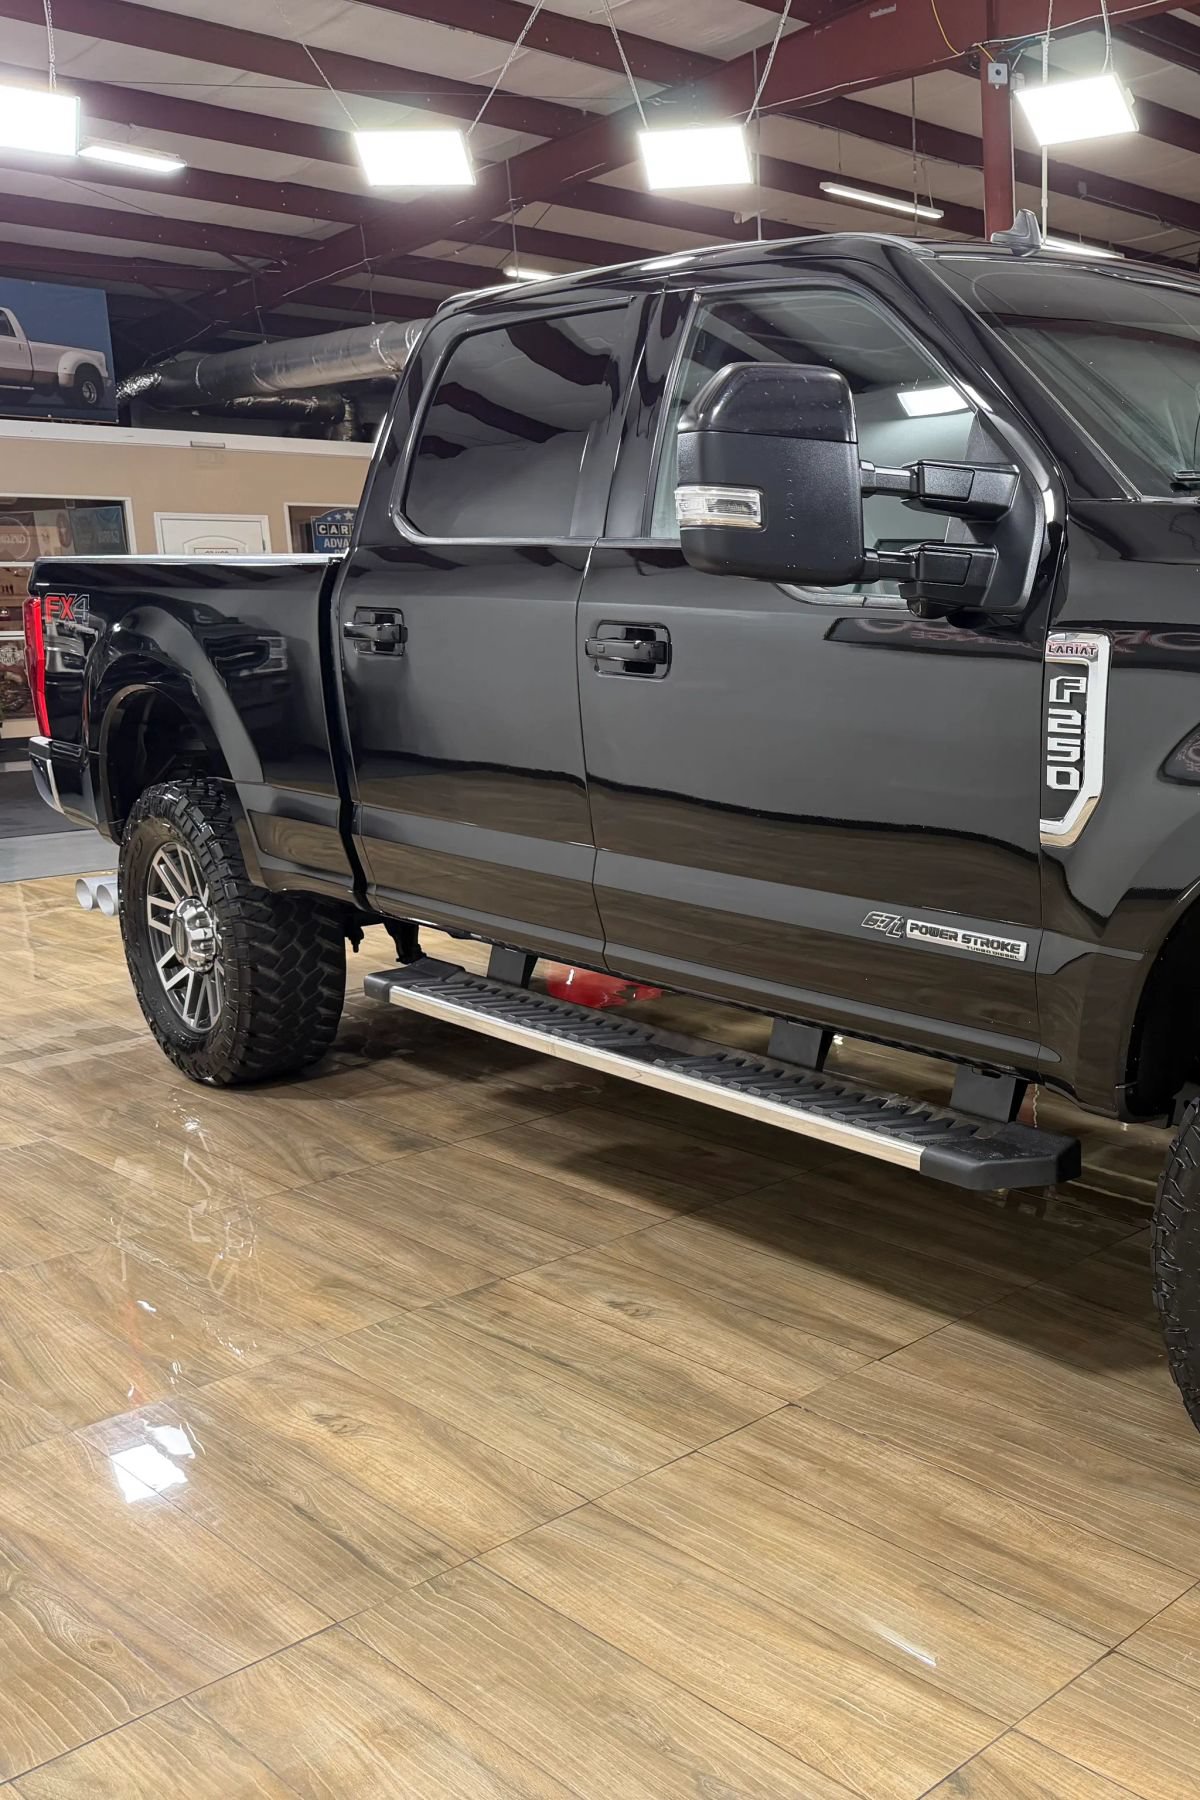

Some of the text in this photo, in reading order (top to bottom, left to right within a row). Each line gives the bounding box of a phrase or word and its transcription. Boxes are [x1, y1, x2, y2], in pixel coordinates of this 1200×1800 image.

[324, 538, 351, 548] ADVA
[45, 593, 89, 624] FX4
[1048, 644, 1097, 656] LARIAT
[1046, 676, 1087, 790] F250
[909, 922, 1021, 955] POWER STROKE
